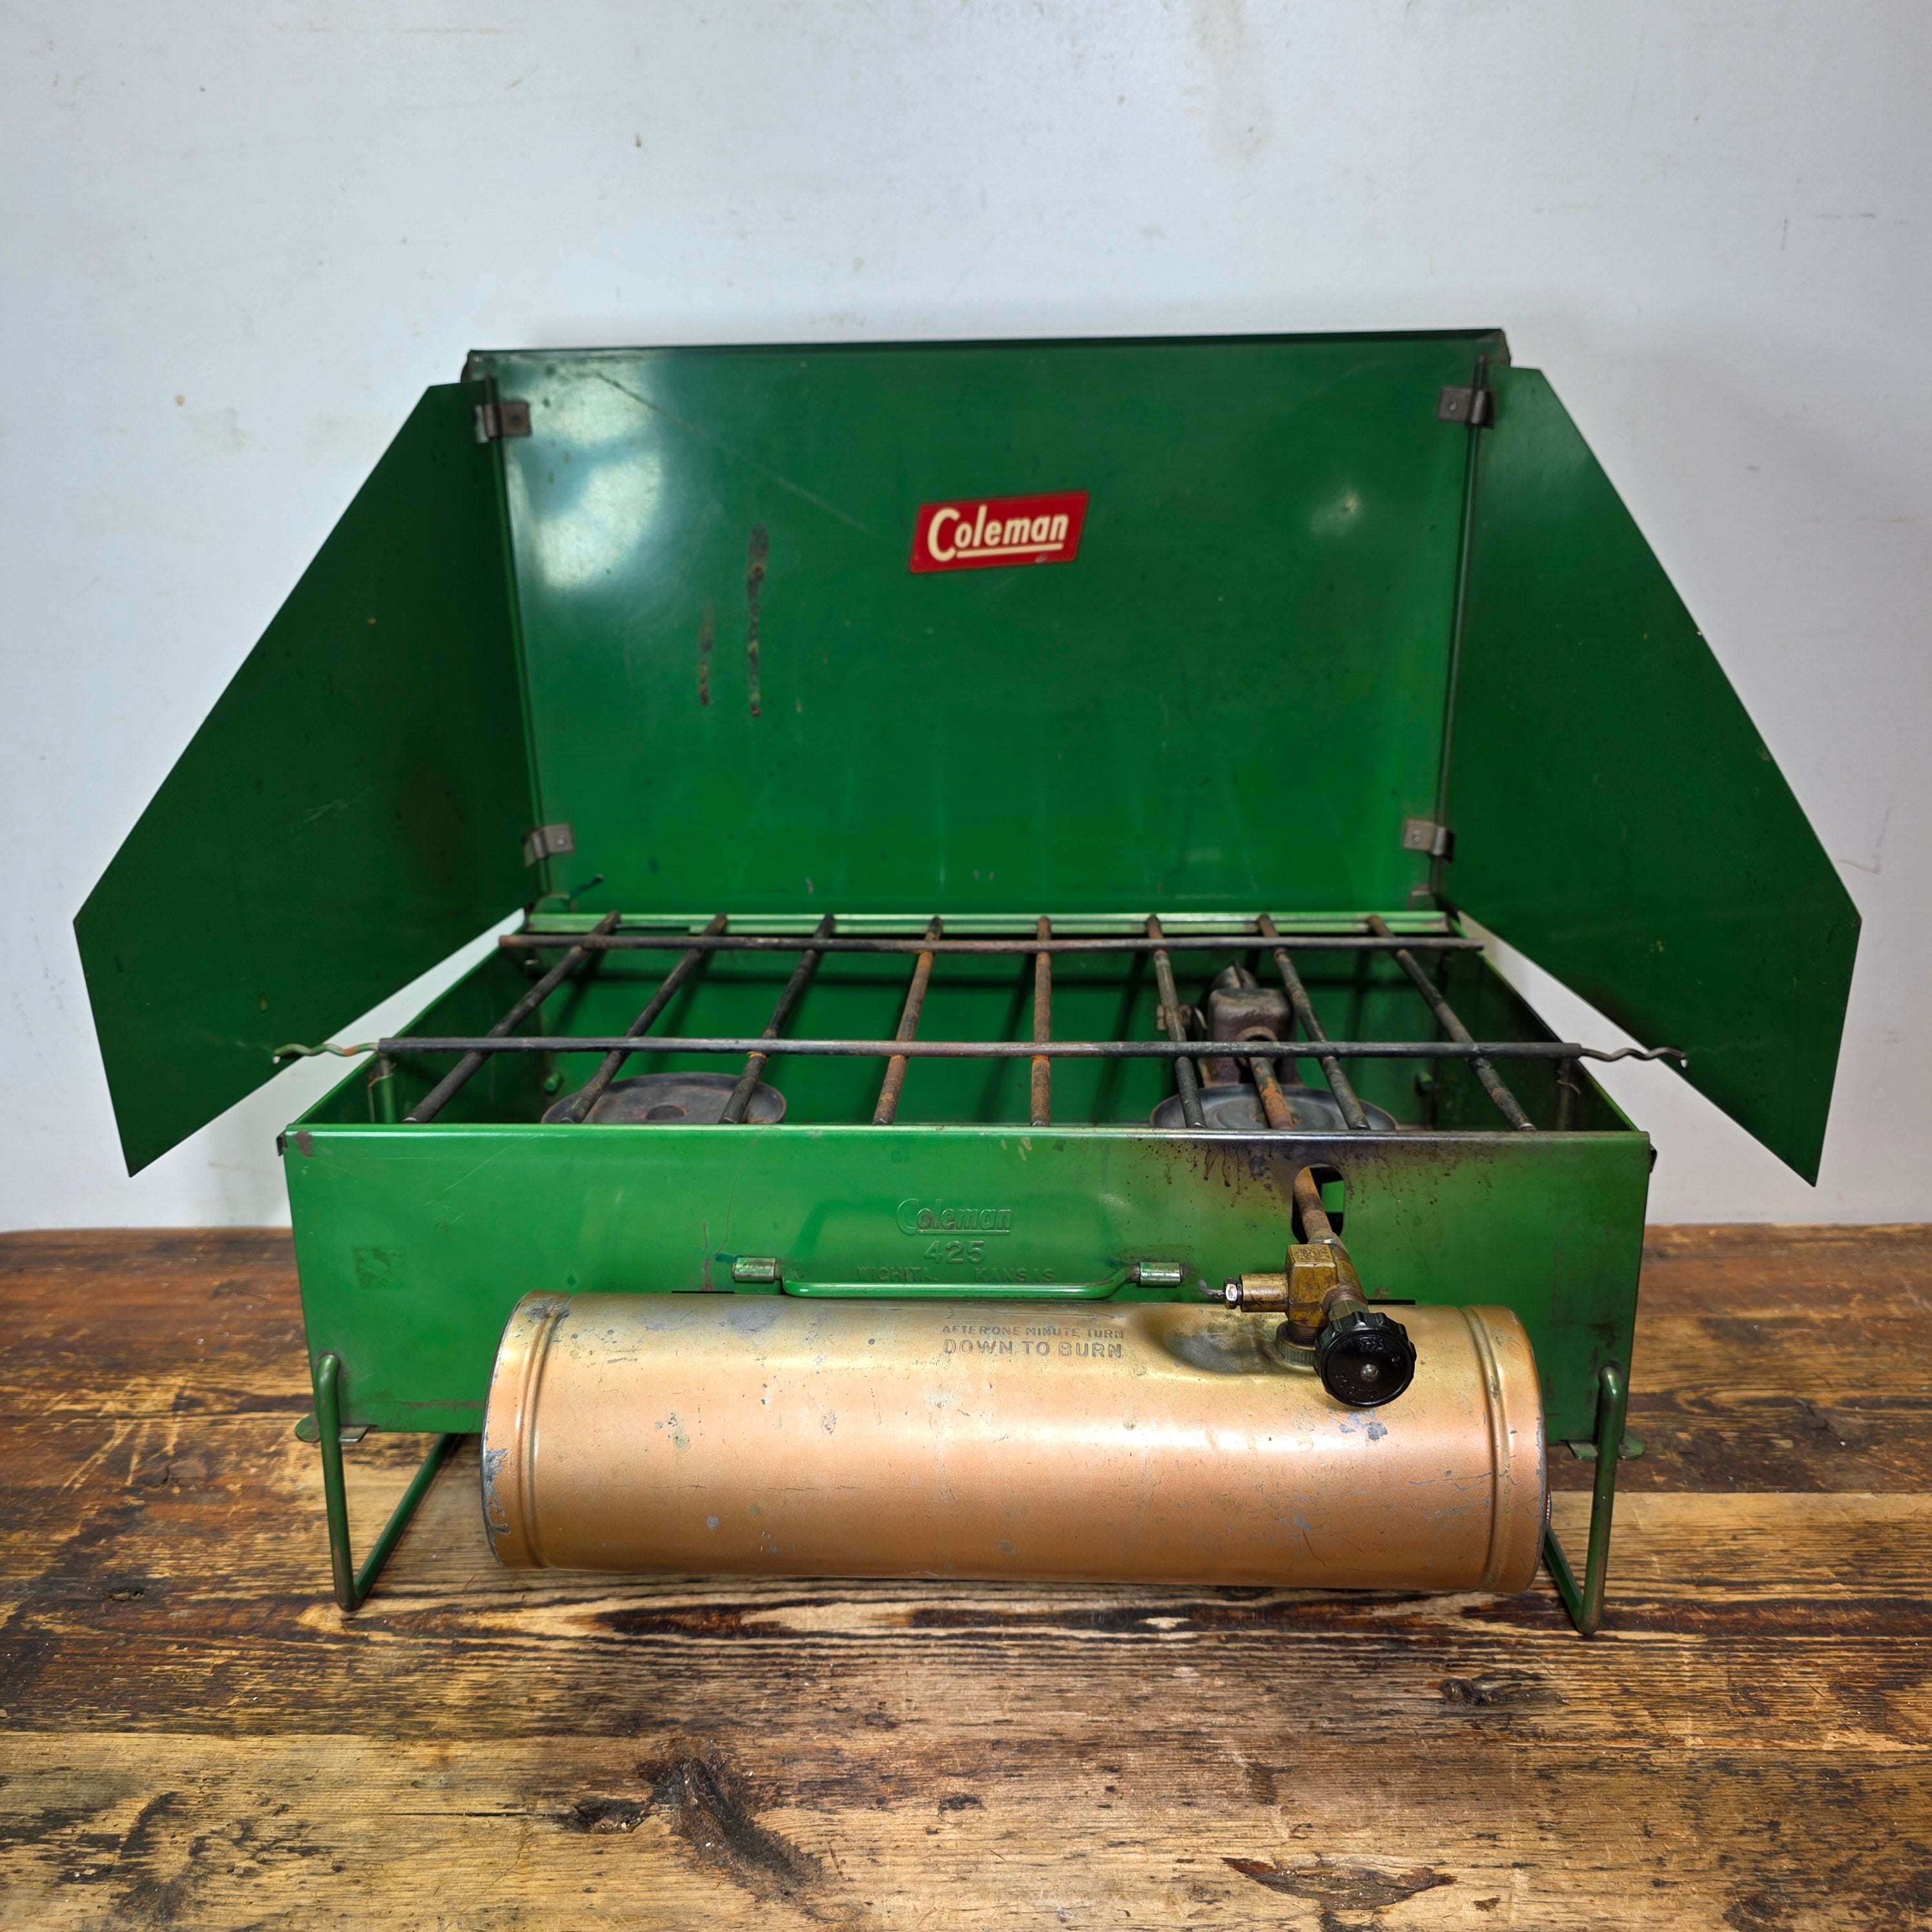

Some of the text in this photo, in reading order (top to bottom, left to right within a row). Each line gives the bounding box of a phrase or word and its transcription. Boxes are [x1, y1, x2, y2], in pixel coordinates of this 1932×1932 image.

[927, 505, 1069, 562] Coleman
[896, 1198, 1012, 1235] Coleman
[923, 1240, 985, 1264] 425
[974, 1268, 1054, 1283] KANSAS
[942, 1325, 1124, 1339] AFTER ONE MINUTE TURN
[943, 1339, 1122, 1358] DOWN TO BURN
